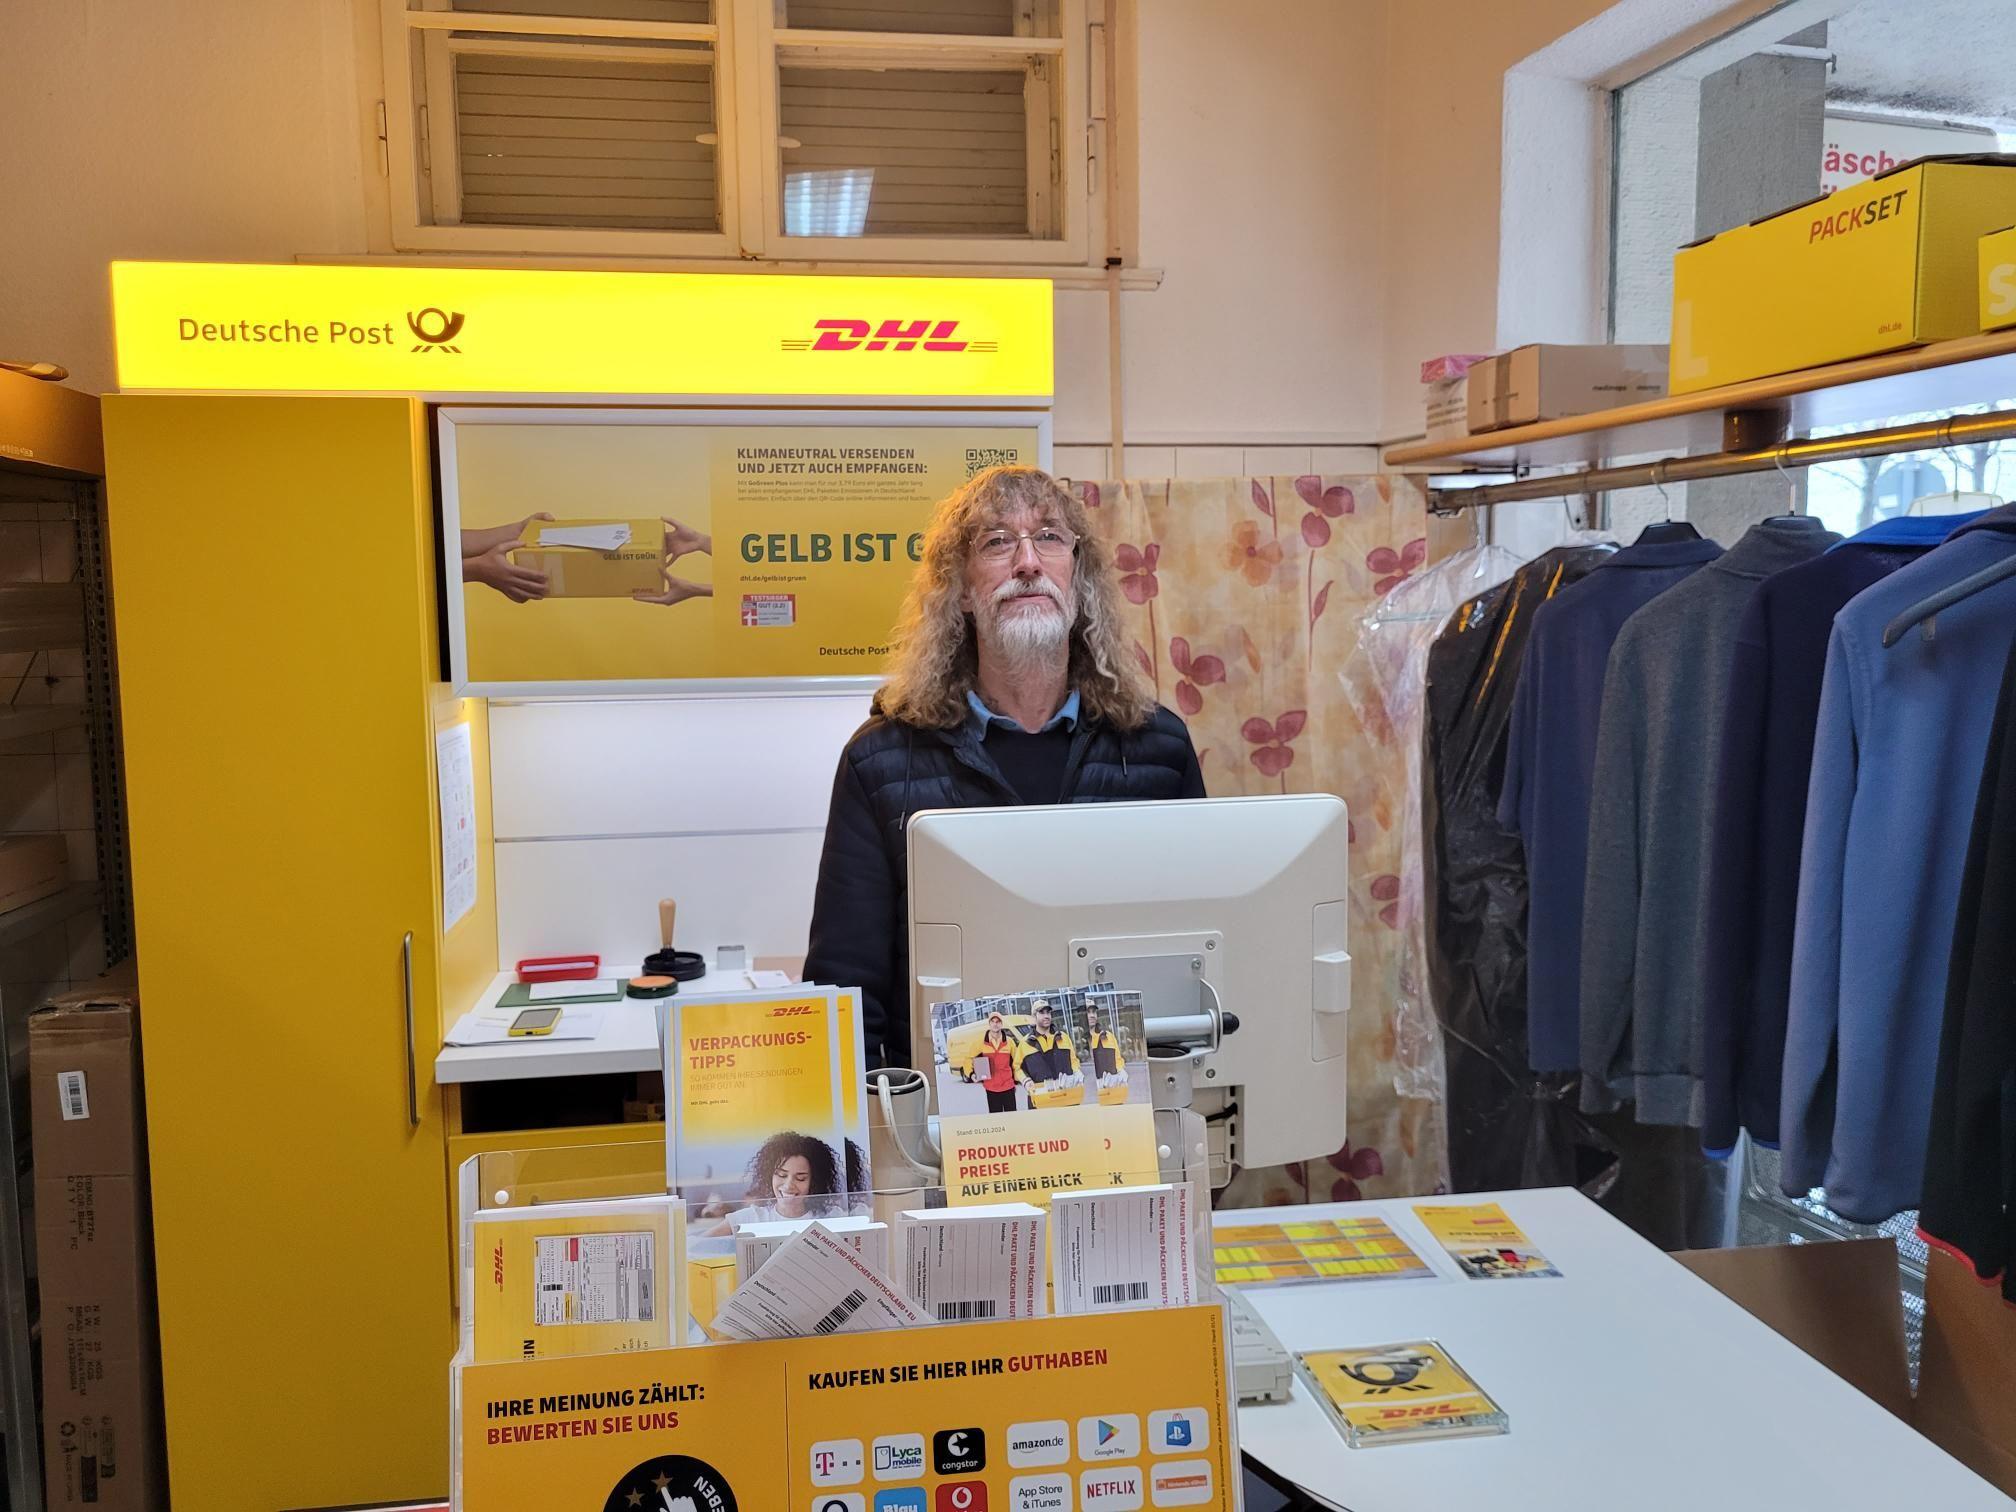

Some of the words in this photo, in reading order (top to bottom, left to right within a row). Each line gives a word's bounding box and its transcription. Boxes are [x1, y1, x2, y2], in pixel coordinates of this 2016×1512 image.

[1809, 190, 1908, 244] PACKSET
[179, 318, 319, 342] Deutsche
[330, 321, 394, 344] Post
[811, 319, 969, 351] DHL
[1878, 322, 1902, 334] dhl.de
[738, 448, 837, 459] KLIMANEUTRAL
[840, 448, 915, 459] VERSENDEN
[738, 463, 765, 474] UND
[769, 463, 805, 474] JETZT
[808, 463, 843, 474] AUCH
[846, 463, 928, 474] EMPFANGEN:
[741, 533, 832, 563] GELB
[843, 533, 897, 562] IST
[819, 647, 866, 656] Deutsche
[772, 1006, 813, 1016] DHL
[689, 1031, 812, 1051] VERPACKUNGS-
[690, 1055, 736, 1069] TIPPS
[975, 1127, 1006, 1135] 01.01.2024
[958, 1141, 1036, 1162] PRODUKTE
[1038, 1139, 1070, 1154] UND
[959, 1162, 1010, 1179] PREISE
[961, 1182, 990, 1197] AUF
[993, 1176, 1037, 1193] EINEN
[1041, 1172, 1083, 1188] BLICK
[803, 1238, 820, 1250] Absender
[1180, 1237, 1188, 1272] PÄCKCHEN
[1159, 1246, 1168, 1281] PÄCKCHEN
[810, 1229, 821, 1239] DHL
[820, 1236, 838, 1250] PAKET
[835, 1247, 848, 1257] UND
[846, 1255, 872, 1278] PÄCKCHEN
[870, 1276, 906, 1310] DEUTSCHLAND
[907, 1312, 916, 1321] EU
[1009, 1266, 1018, 1300] PÄCKCHEN
[1027, 1265, 1037, 1298] PÄCKCHEN
[754, 1281, 776, 1297] Deutschland
[877, 1298, 897, 1319] Empfänger
[1026, 1299, 1034, 1320] DEUT
[809, 1367, 885, 1390] KAUFEN
[890, 1365, 919, 1383] SIE
[923, 1361, 967, 1380] HIER
[972, 1358, 1004, 1376] IHR
[1008, 1349, 1108, 1373] GUTHABEN
[487, 1399, 535, 1419] IHRE
[539, 1389, 635, 1414] MEINUNG
[639, 1382, 705, 1405] ZÄHLT:
[1380, 1404, 1462, 1419] DHL
[487, 1419, 598, 1445] BEWERTEN
[602, 1415, 633, 1434] SIE
[638, 1411, 679, 1431] UNS
[1012, 1436, 1064, 1450] amazon.de
[1094, 1448, 1114, 1456] Google
[1115, 1447, 1125, 1455] Play
[892, 1446, 922, 1460] Lyca
[892, 1456, 922, 1467] mobile
[942, 1460, 979, 1471] congstar
[1018, 1487, 1037, 1498] App
[1039, 1485, 1063, 1495] Store
[1087, 1480, 1136, 1498] NETFLIX
[1022, 1501, 1030, 1509] &
[1031, 1498, 1061, 1509] iTunes
